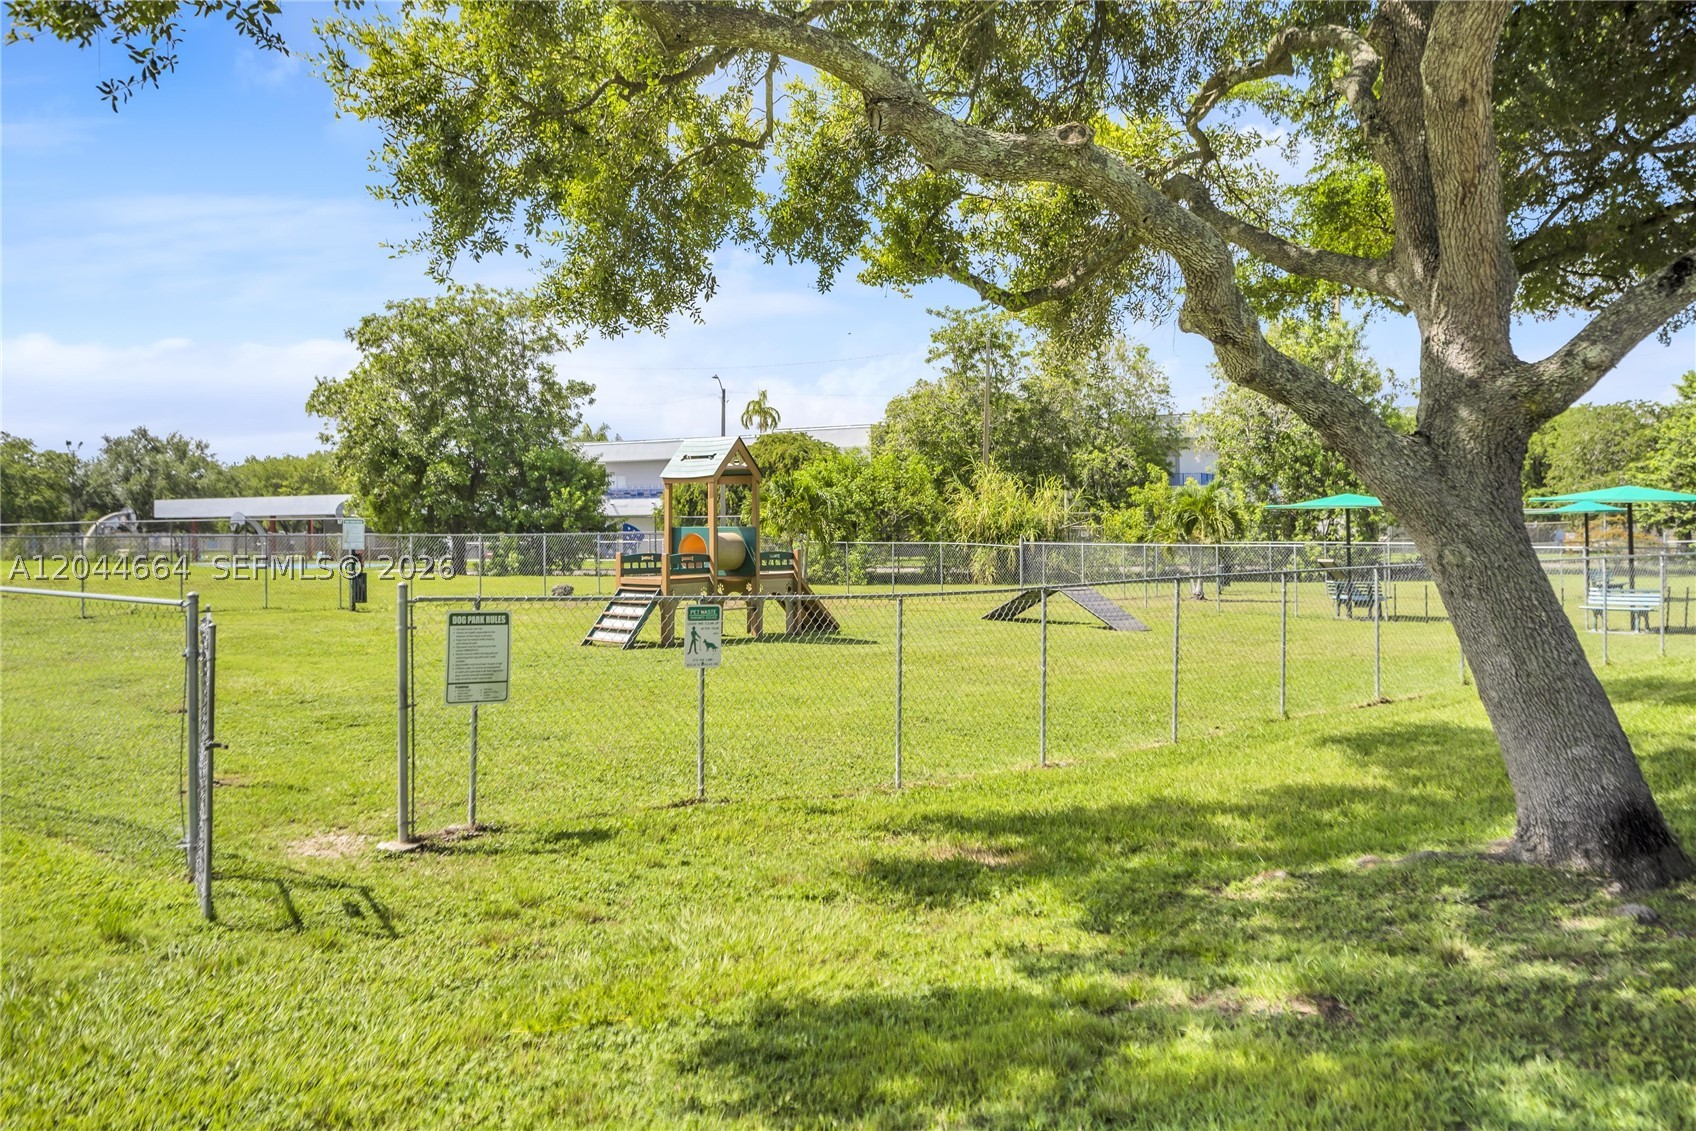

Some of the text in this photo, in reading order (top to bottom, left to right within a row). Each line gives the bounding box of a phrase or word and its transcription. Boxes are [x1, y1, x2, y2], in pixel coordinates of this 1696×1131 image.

[452, 615, 506, 624] DOG PARK RULES
